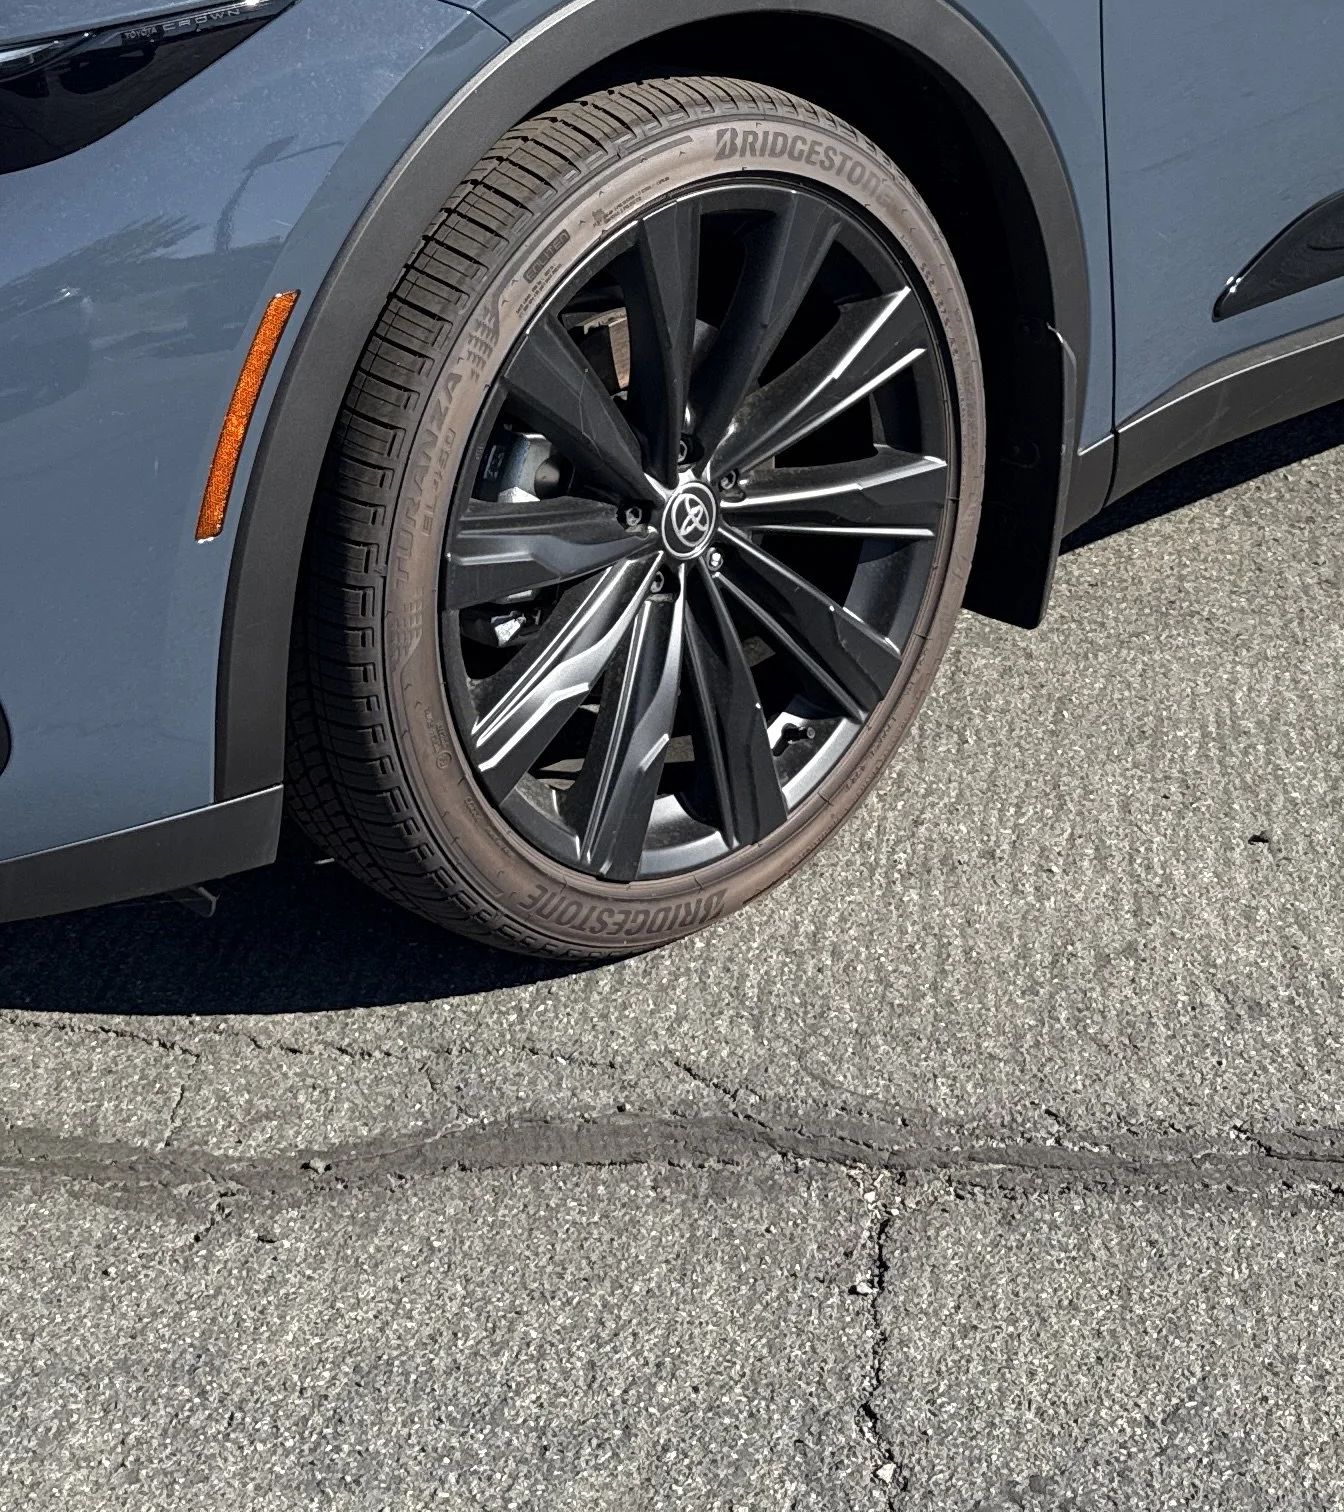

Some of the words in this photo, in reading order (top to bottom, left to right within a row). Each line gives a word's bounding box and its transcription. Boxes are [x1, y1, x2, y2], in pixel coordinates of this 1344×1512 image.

[124, 27, 157, 39] TOYOTA
[162, 8, 240, 32] CROWN
[714, 127, 896, 209] BRIDGESTONE
[396, 373, 462, 587] TURANZA
[519, 883, 728, 937] BRIDGESTONE
